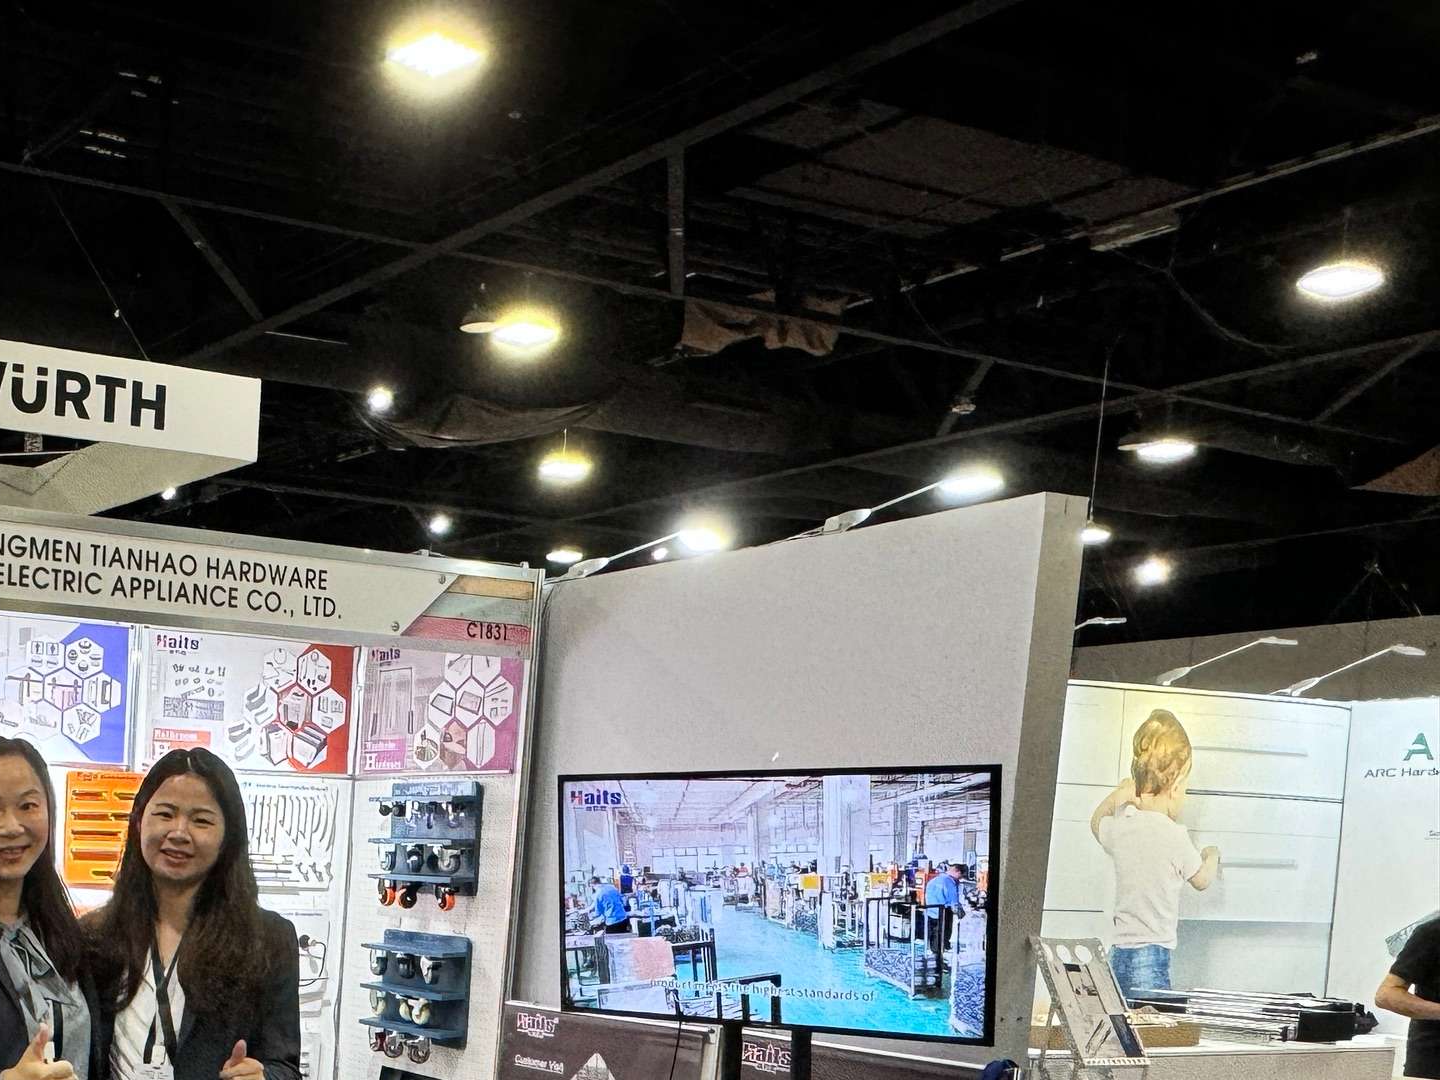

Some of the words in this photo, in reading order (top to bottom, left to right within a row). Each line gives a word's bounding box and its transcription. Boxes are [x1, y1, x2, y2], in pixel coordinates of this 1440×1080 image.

[90, 544, 197, 576] TIANHAO
[207, 557, 328, 590] HARDWARE
[110, 576, 239, 608] APPLIANCE
[247, 589, 294, 618] CO.,
[303, 595, 342, 619] LTD.
[466, 622, 507, 641] C1831
[1364, 768, 1397, 778] ARC
[797, 988, 859, 1000] standards
[861, 991, 875, 1002] of
